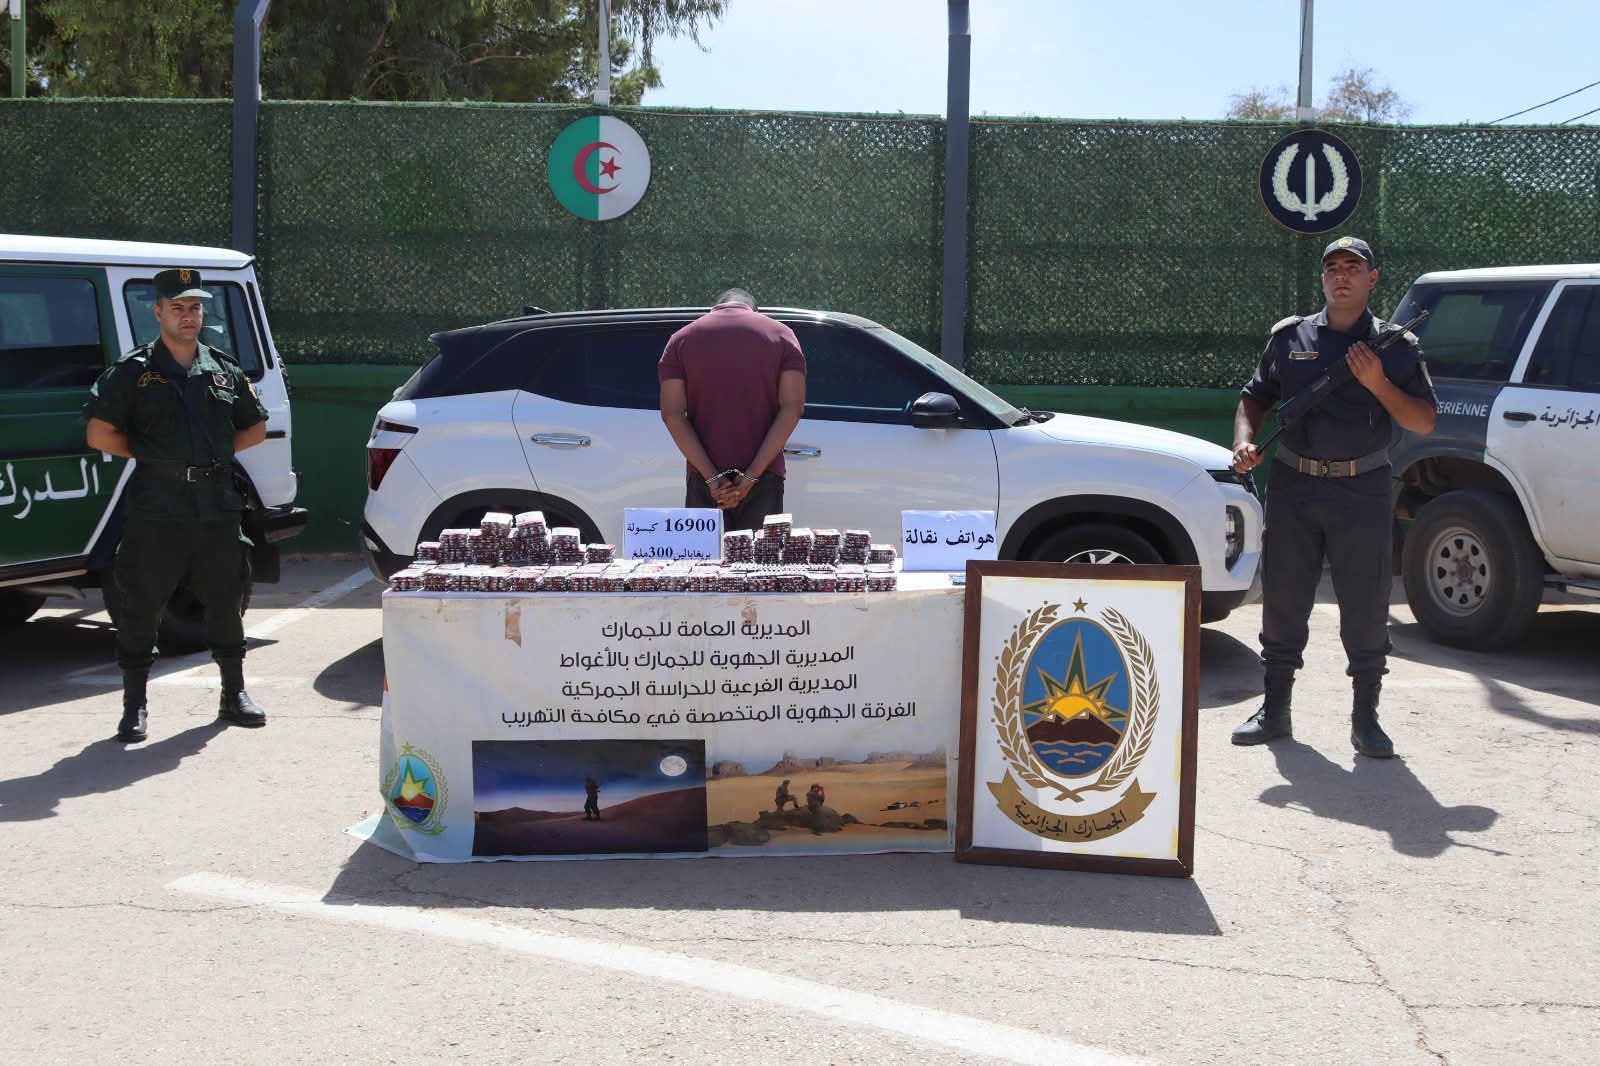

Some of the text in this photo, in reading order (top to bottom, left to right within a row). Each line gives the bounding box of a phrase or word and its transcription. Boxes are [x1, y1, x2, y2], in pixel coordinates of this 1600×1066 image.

[627, 518, 716, 535] 16900 كبسولة
[905, 528, 995, 550] هواتف نقالة
[602, 618, 811, 642] المديرية العامة للجمارك
[559, 646, 854, 672] المديرية الجهوية للجمارك بالأغواط
[561, 674, 858, 701] المديرية الفرعية للحراسة الجمركية
[501, 702, 917, 728] الفرقة الجهوية المتخصصة في مكافحة التهريب
[1014, 800, 1128, 838] الجمارك الجزائرية
